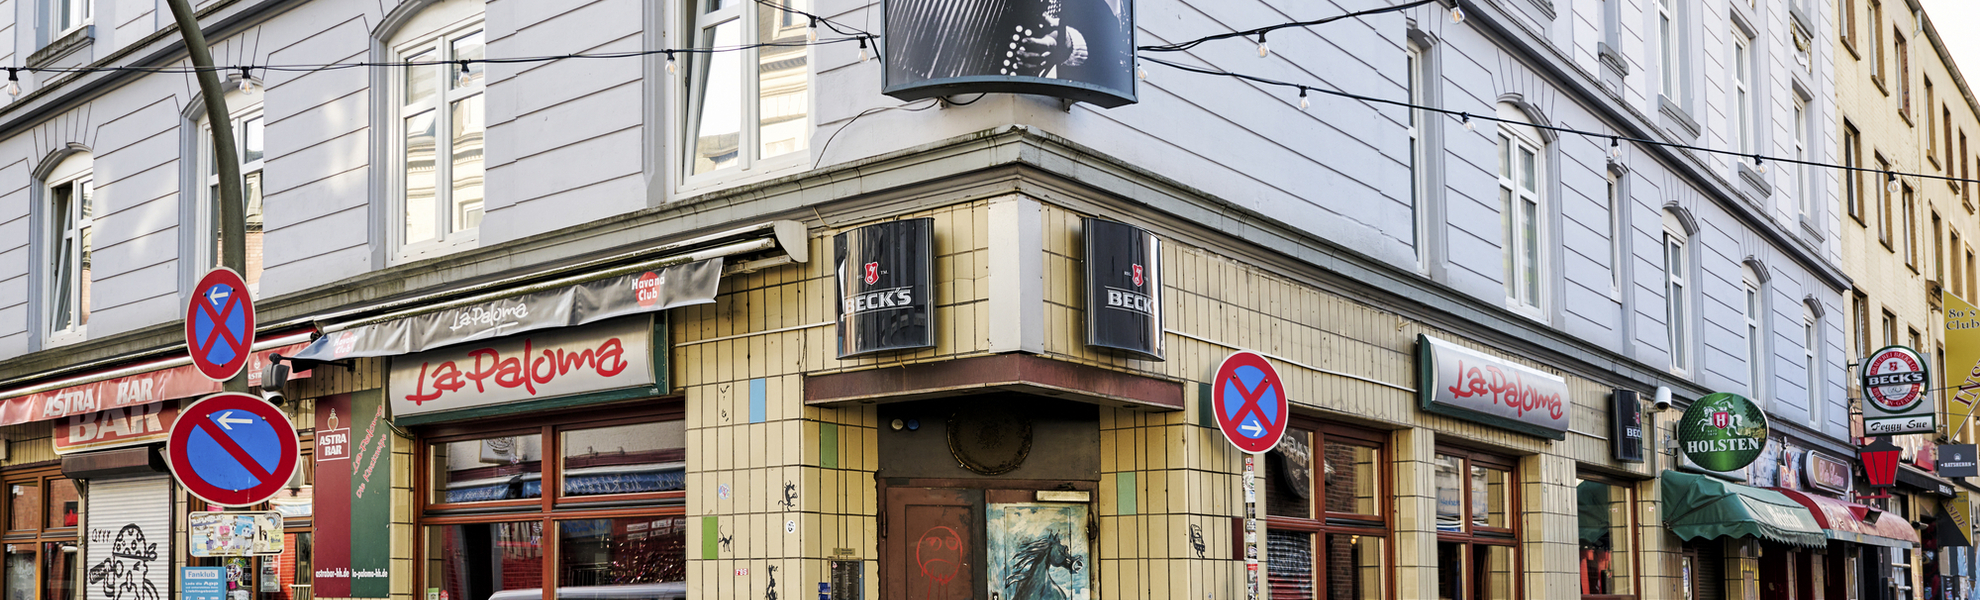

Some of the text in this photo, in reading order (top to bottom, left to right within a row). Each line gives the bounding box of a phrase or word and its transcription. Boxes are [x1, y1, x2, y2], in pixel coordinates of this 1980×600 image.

[631, 275, 665, 291] Havana
[638, 288, 658, 301] Club
[844, 287, 912, 315] BECK'S
[1107, 289, 1153, 314] BECK
[1946, 318, 1980, 330] Club
[333, 335, 358, 346] Havana
[335, 344, 351, 354] Club
[1872, 352, 1893, 374] BRAUEREI
[1894, 352, 1909, 363] BECK
[1868, 372, 1923, 386] BECK'S
[1952, 359, 1980, 409] INS
[42, 378, 154, 418] ASTRA BAR
[69, 401, 163, 444] BAR
[1870, 420, 1927, 432] Peggy Sue
[319, 433, 348, 446] ASTRA
[1626, 428, 1642, 438] BEC
[324, 445, 342, 456] BAR
[1687, 438, 1760, 454] HOLSTEN
[1943, 500, 1967, 528] NSIDE
[316, 568, 350, 578] astrabar-hh.de
[352, 568, 388, 580] la-paloma-hh.de
